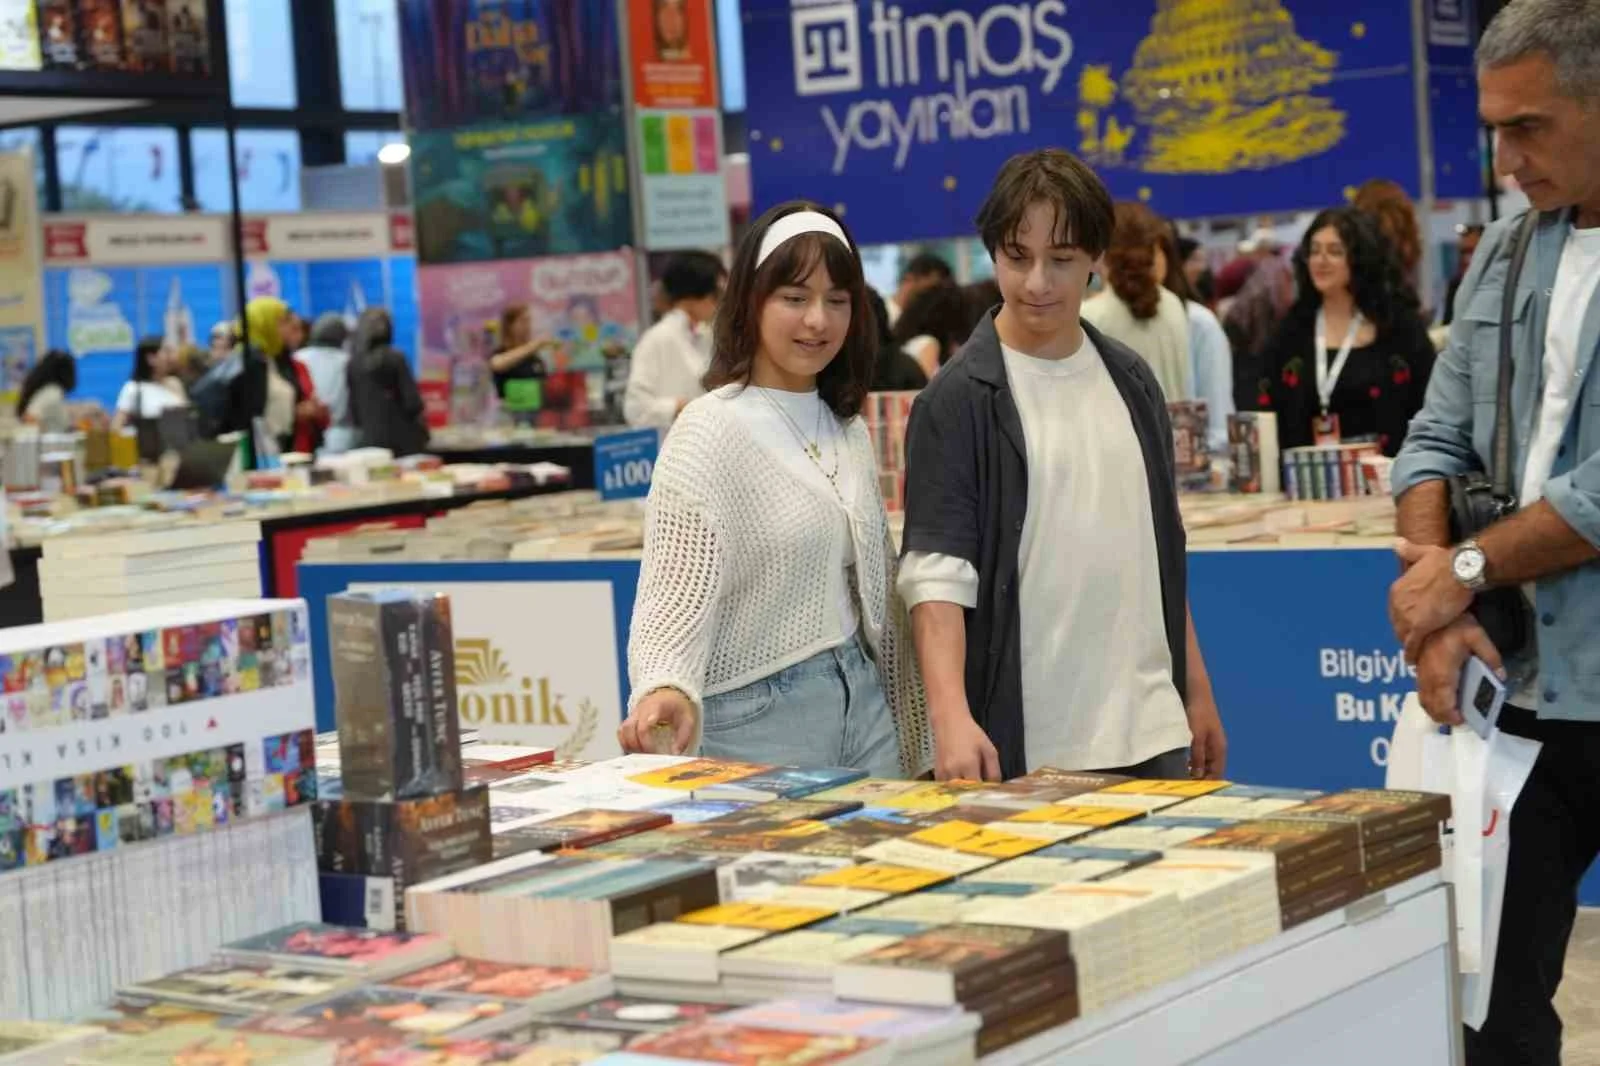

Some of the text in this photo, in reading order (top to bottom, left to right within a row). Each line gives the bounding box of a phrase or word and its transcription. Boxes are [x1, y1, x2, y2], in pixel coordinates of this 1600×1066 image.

[869, 0, 1073, 94] timaş
[461, 677, 569, 725] onik
[1335, 692, 1375, 722] Bu
